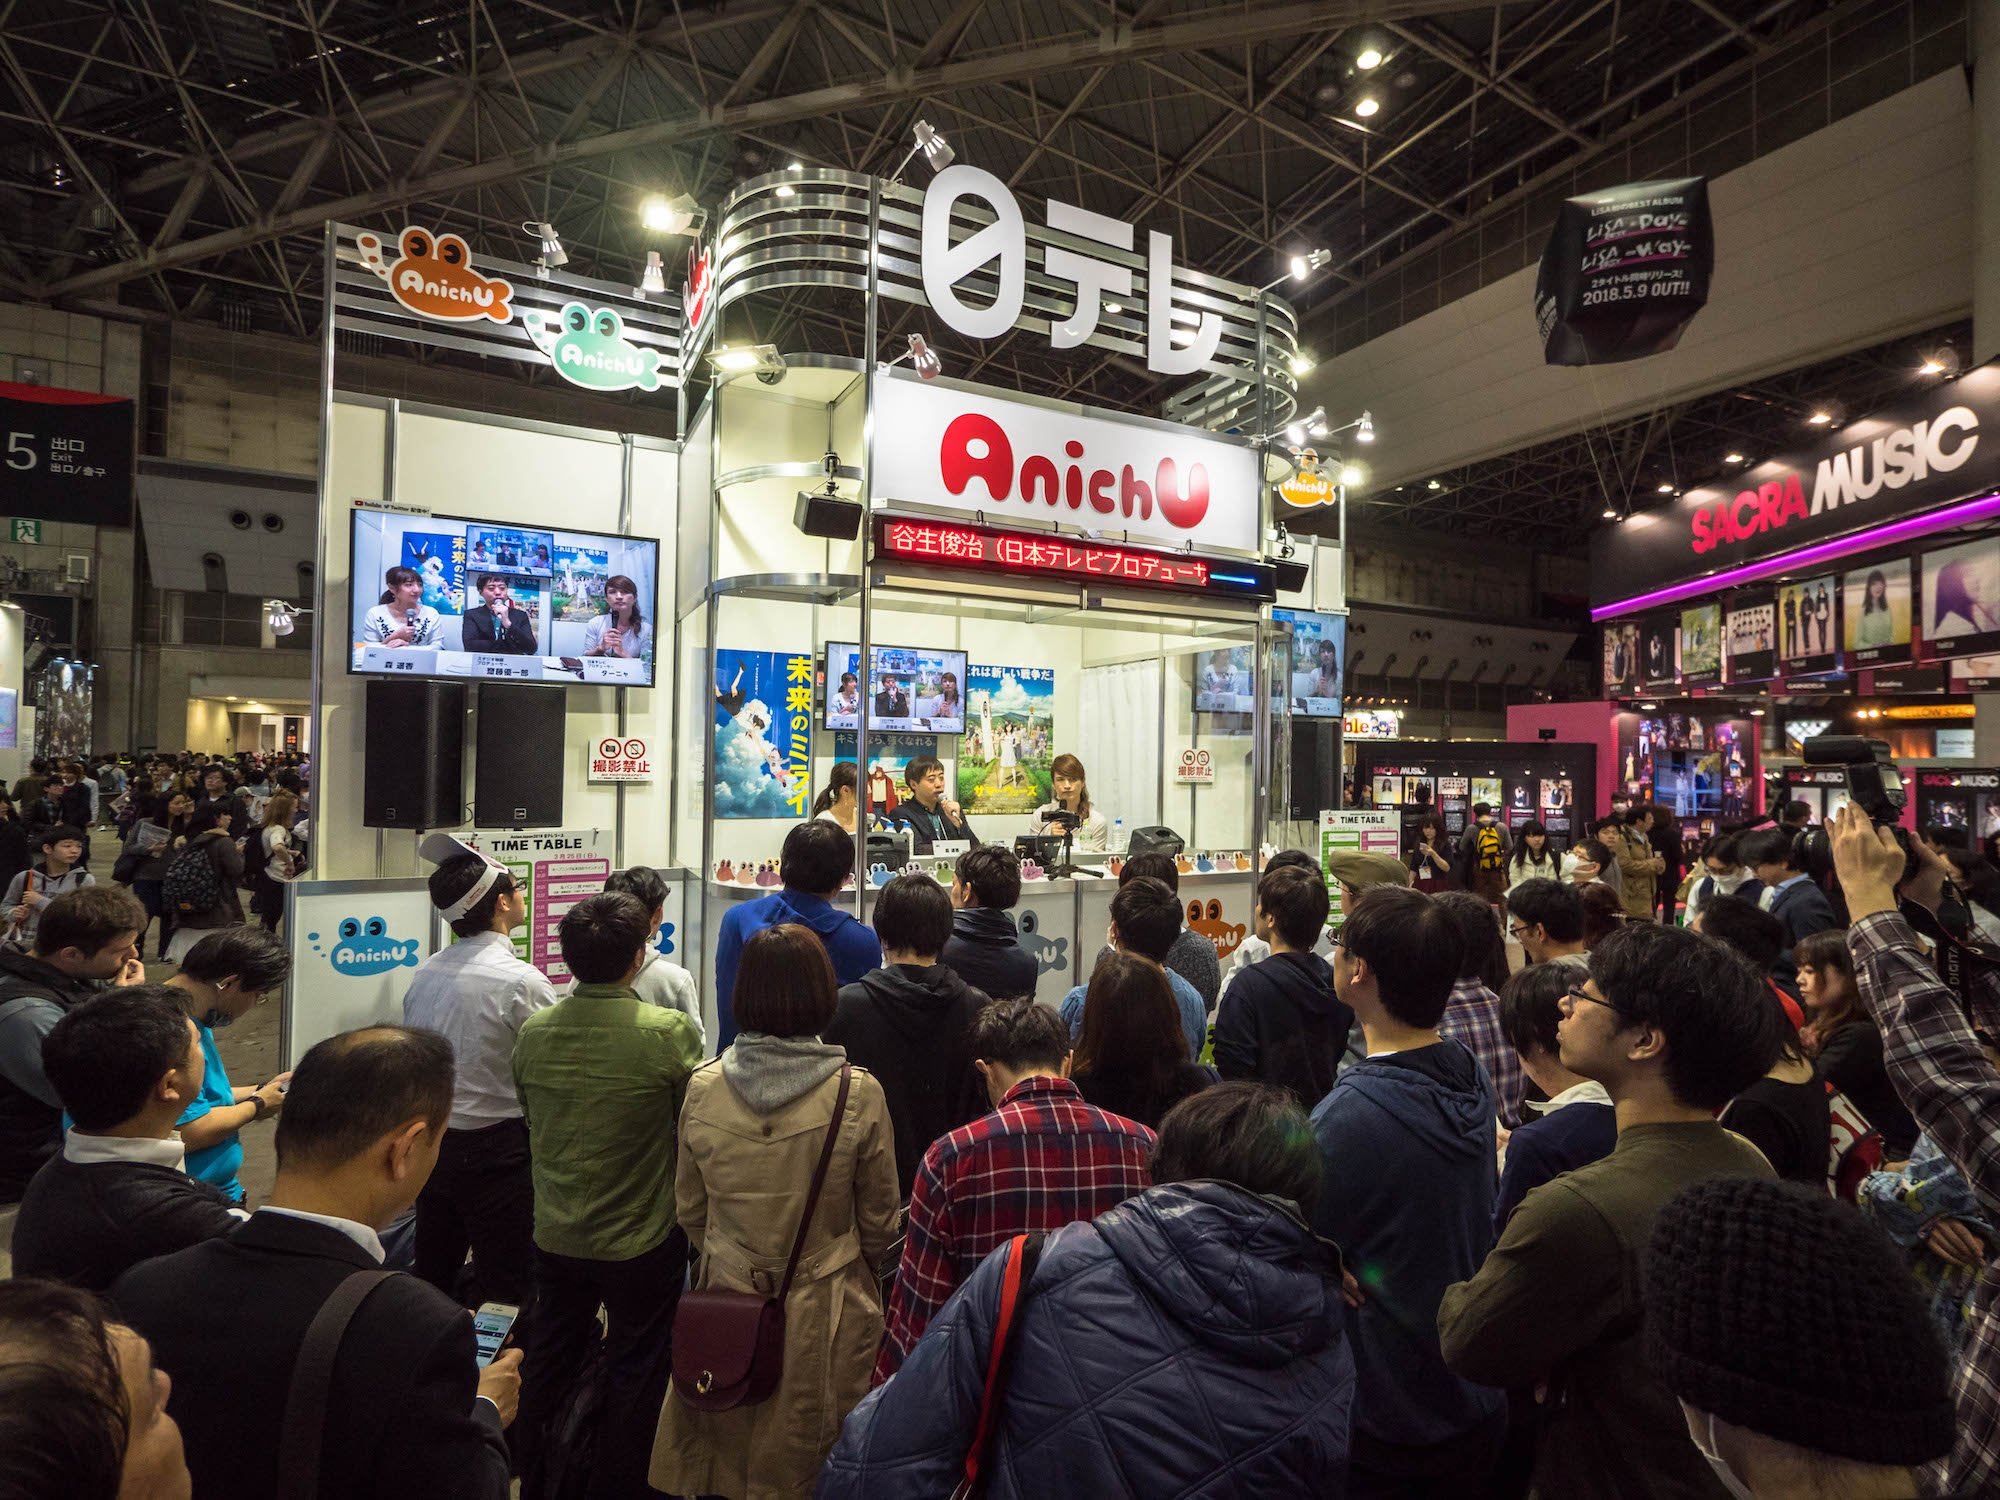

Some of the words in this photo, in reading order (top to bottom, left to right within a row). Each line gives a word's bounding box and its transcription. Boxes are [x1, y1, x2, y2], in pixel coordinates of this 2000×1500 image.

[922, 164, 1222, 375] 日テレ
[399, 269, 495, 307] AnichU
[1583, 283, 1648, 306] 2018.5.9
[1652, 281, 1690, 297] OUT!!
[561, 343, 645, 377] AnichU
[6, 432, 37, 470] 5
[51, 437, 85, 452] 出口
[51, 452, 73, 463] Exit
[941, 413, 1209, 529] AnichU
[1691, 473, 1809, 554] SACRA
[1810, 406, 1980, 517] MUSIC
[1284, 477, 1328, 495] AnichU
[968, 665, 1054, 682] れは新しい戦争だ。
[786, 656, 812, 815] 未来のミライ
[593, 760, 651, 773] 撮影禁止
[1815, 771, 1844, 783] MUSIC
[1960, 774, 1999, 787] MUSIC
[1340, 816, 1359, 824] TIME
[1361, 816, 1385, 824] TABLE
[491, 839, 529, 852] TIME
[533, 838, 582, 850] TABLE
[336, 945, 408, 965] AnichU
